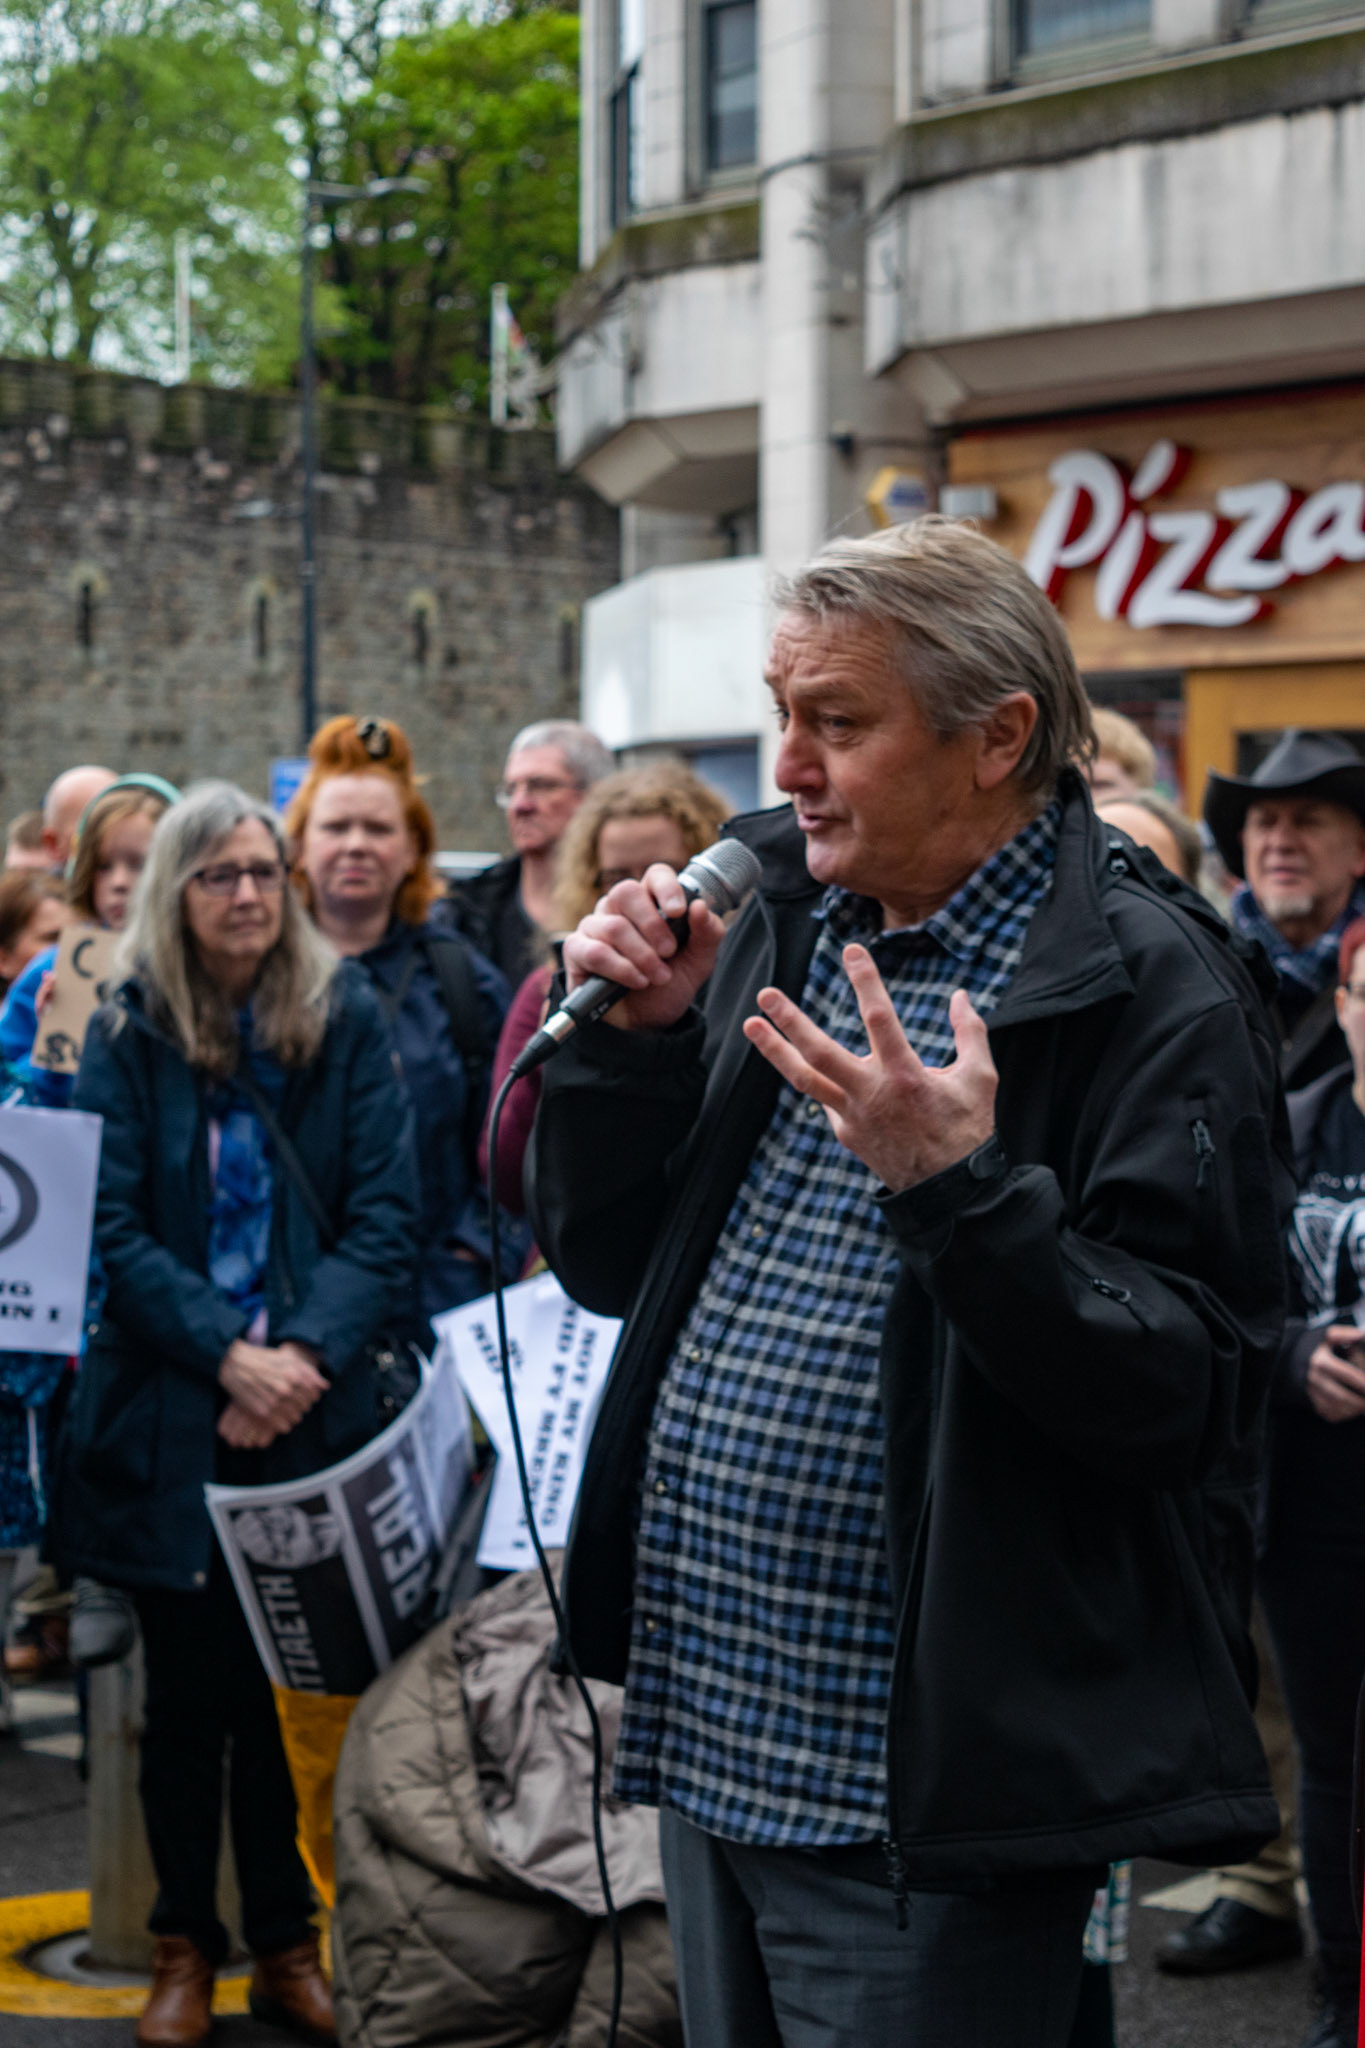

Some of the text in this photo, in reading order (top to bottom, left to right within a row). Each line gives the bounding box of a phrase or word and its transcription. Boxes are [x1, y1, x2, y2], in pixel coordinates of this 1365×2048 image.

[1026, 438, 1365, 630] Pizza
[571, 1328, 597, 1387] NOT
[559, 1399, 581, 1440] MY
[365, 1453, 433, 1619] REAL
